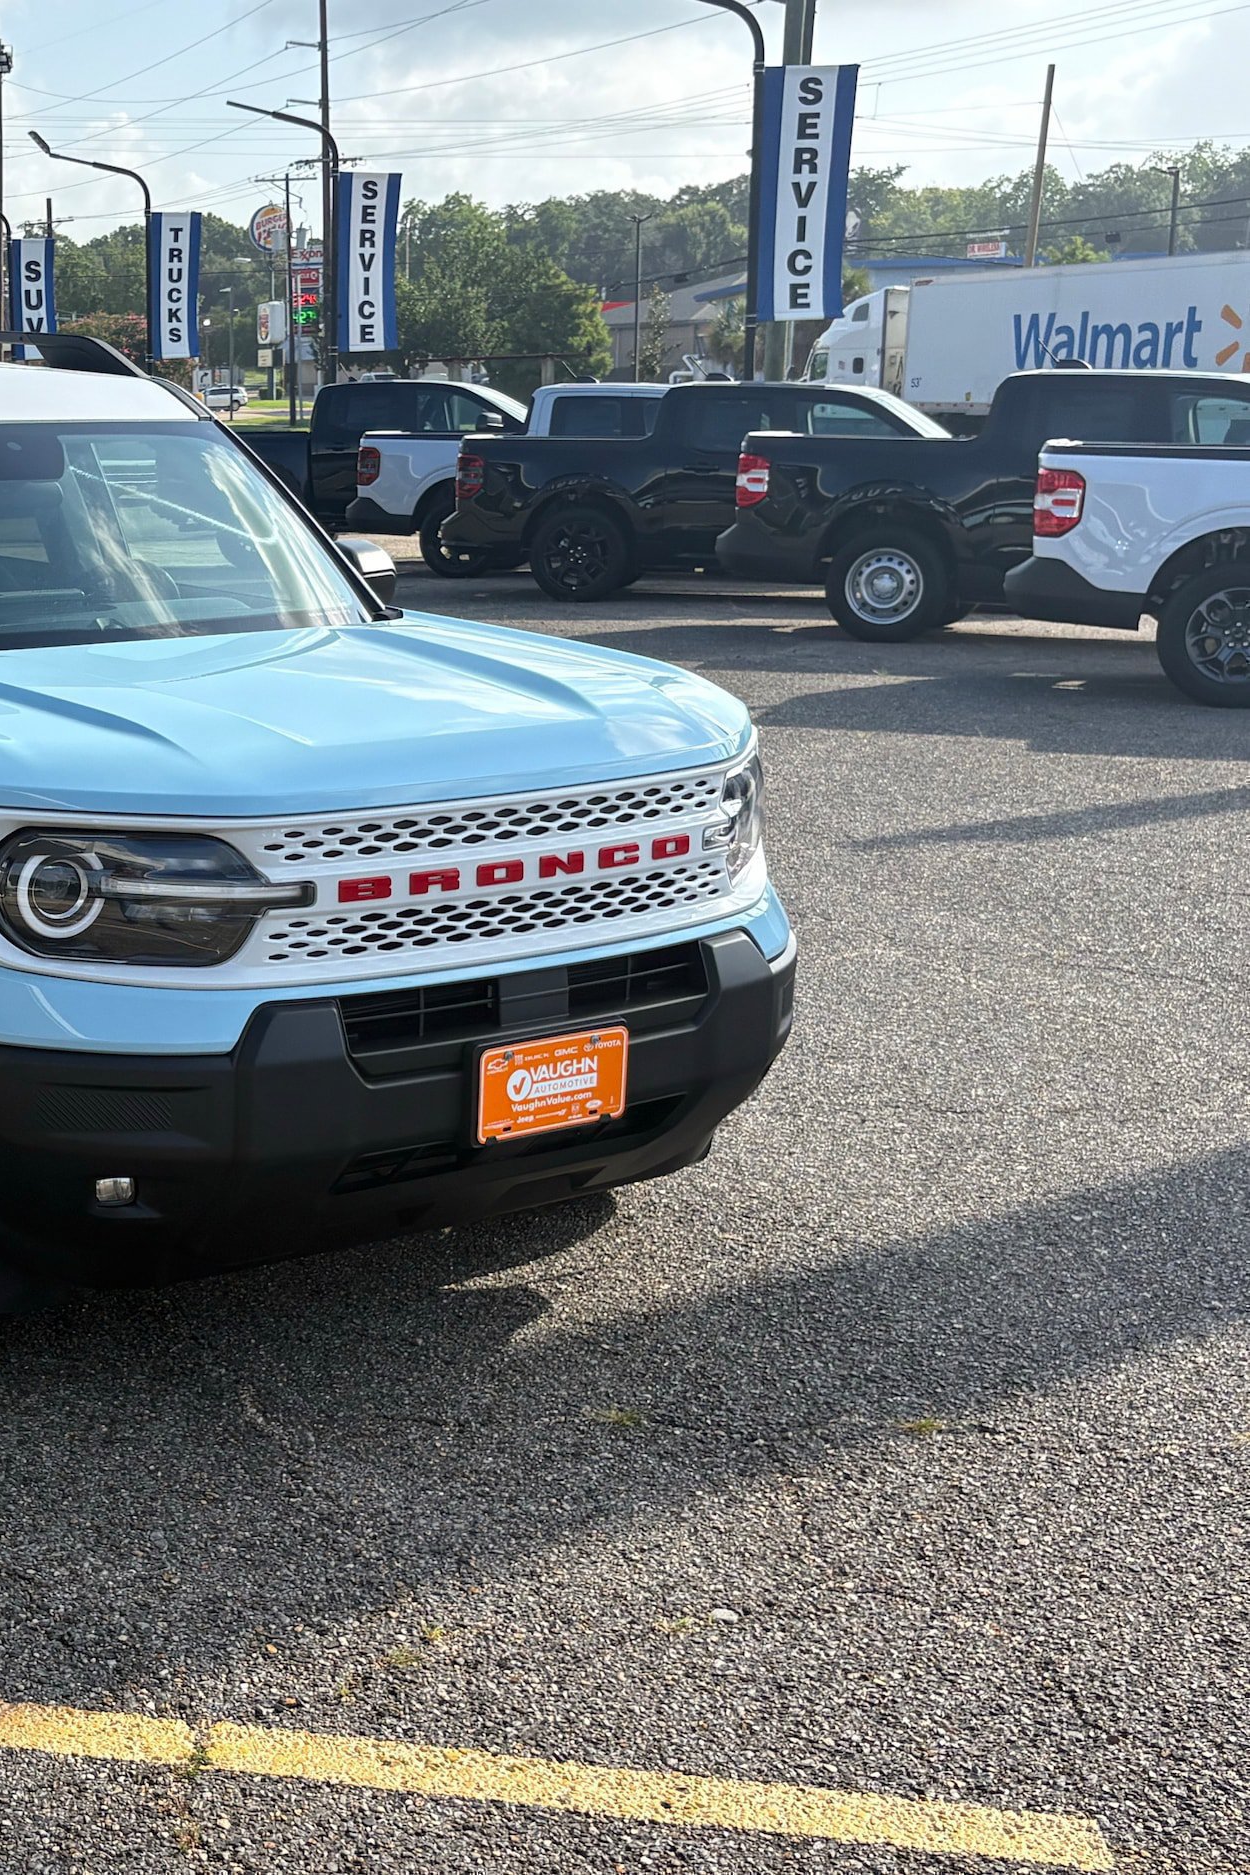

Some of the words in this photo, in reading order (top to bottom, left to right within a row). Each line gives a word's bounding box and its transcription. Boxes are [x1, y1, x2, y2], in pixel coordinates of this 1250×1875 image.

[786, 76, 824, 310] SERVICE
[167, 227, 184, 344] TRUCKS
[357, 180, 379, 344] SERVICE
[24, 260, 45, 334] SUV
[1013, 306, 1203, 370] Walmart
[338, 832, 690, 904] BRONCO
[530, 1055, 598, 1081] VAUGHN
[554, 1046, 579, 1057] GMC
[595, 1040, 622, 1049] TOYOTA
[511, 1092, 593, 1113] VaughnValue.com
[534, 1076, 595, 1094] AUTOMOTIVE
